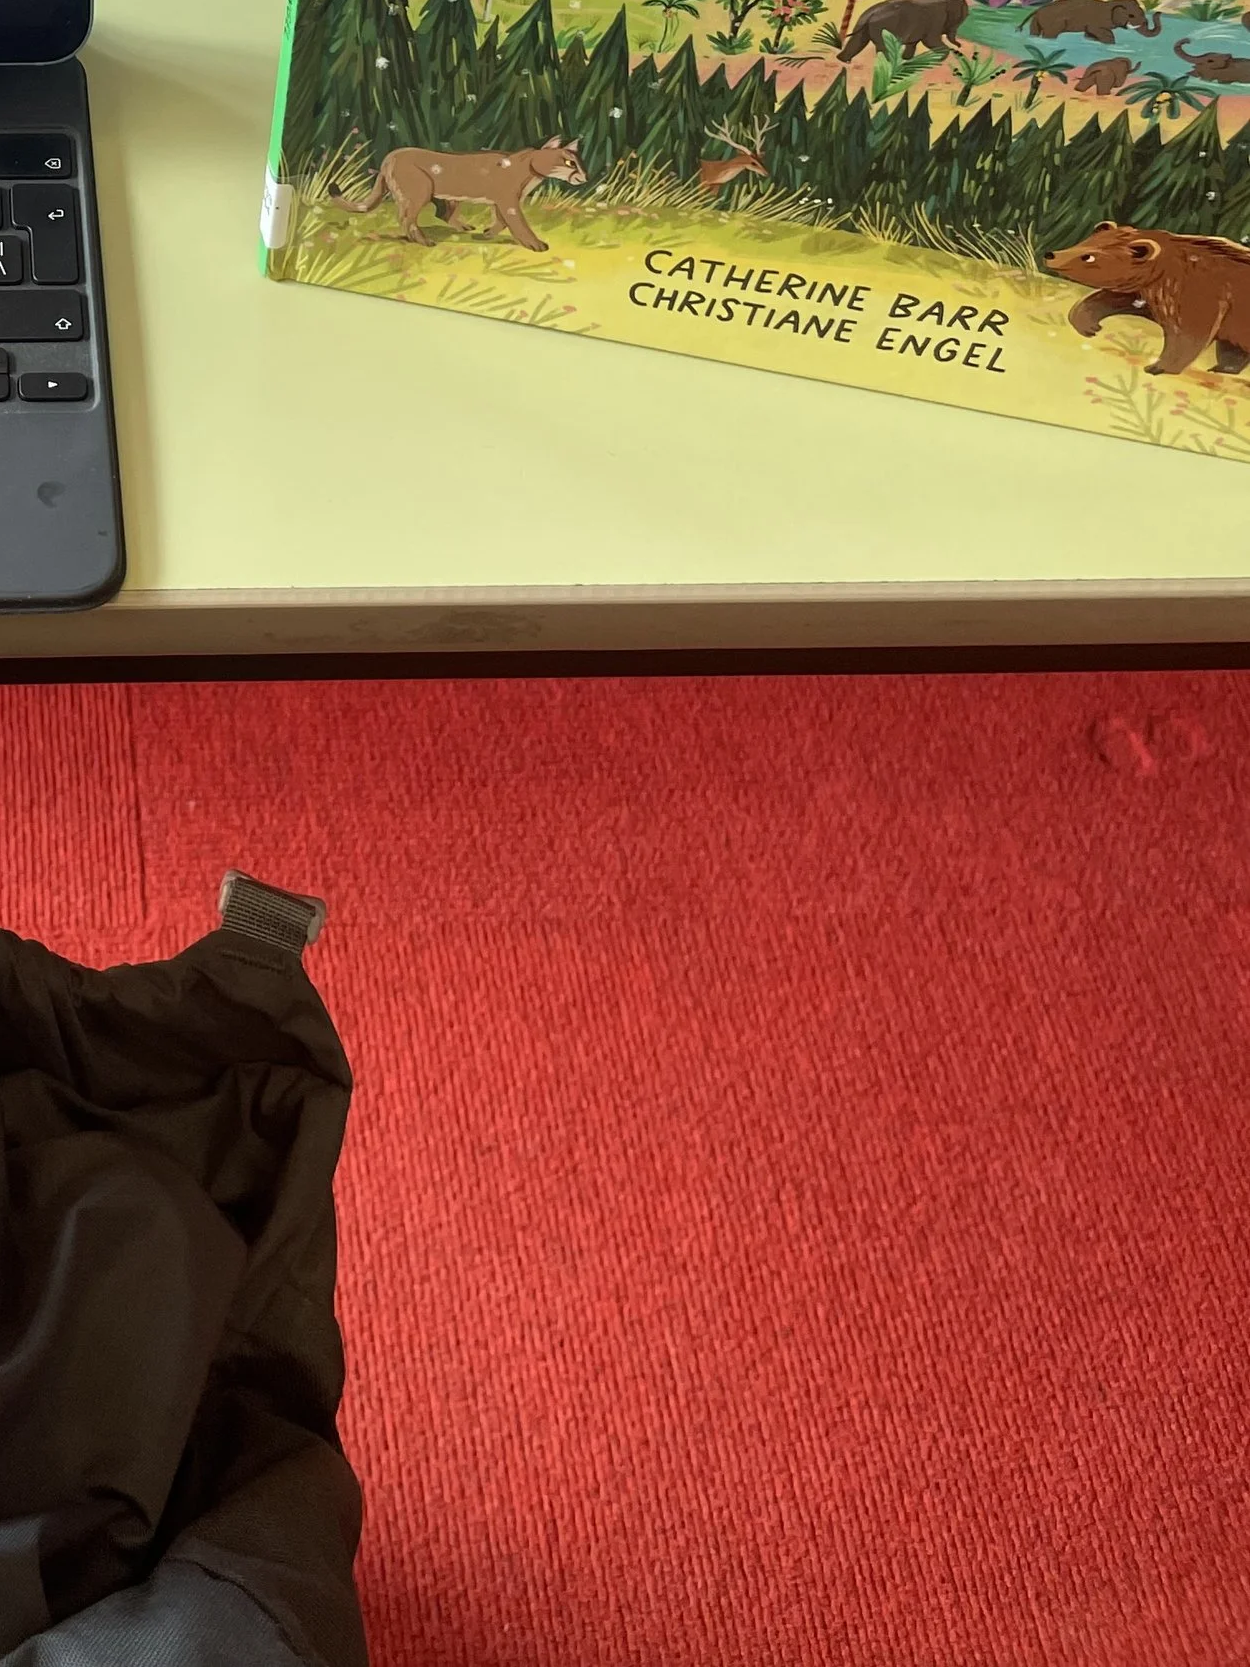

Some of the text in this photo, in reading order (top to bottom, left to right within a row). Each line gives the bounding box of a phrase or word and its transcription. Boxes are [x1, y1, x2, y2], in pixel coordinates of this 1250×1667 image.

[628, 282, 1007, 373] CHRISTIANE ENGEL
[644, 249, 1010, 337] CATHERINE BARR
